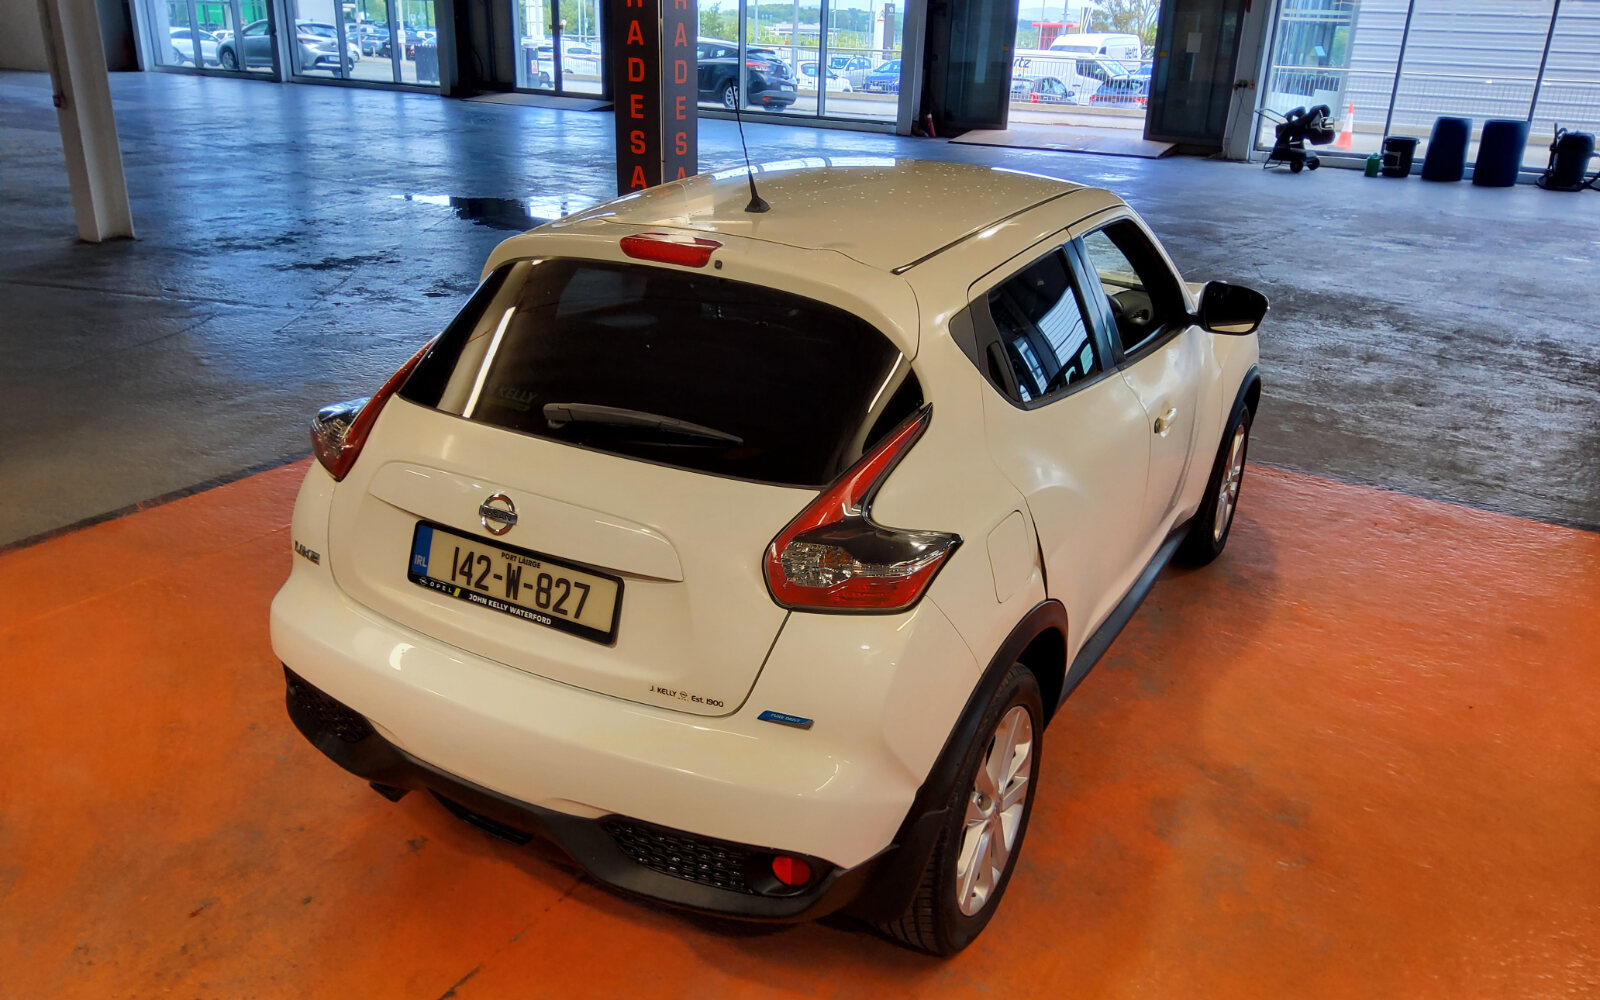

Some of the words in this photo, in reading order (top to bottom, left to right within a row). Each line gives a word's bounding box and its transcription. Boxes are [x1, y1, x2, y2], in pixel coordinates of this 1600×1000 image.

[1013, 56, 1031, 68] rtz
[294, 540, 320, 566] UKE
[414, 554, 428, 567] IRL
[501, 551, 517, 562] PORT
[429, 581, 453, 593] OPEL
[451, 547, 591, 619] 142-W-827
[468, 593, 487, 605] JOHN
[488, 599, 509, 611] KELLY
[509, 606, 552, 625] WATERFORD
[657, 687, 677, 697] KELLY
[706, 698, 724, 708] 1900
